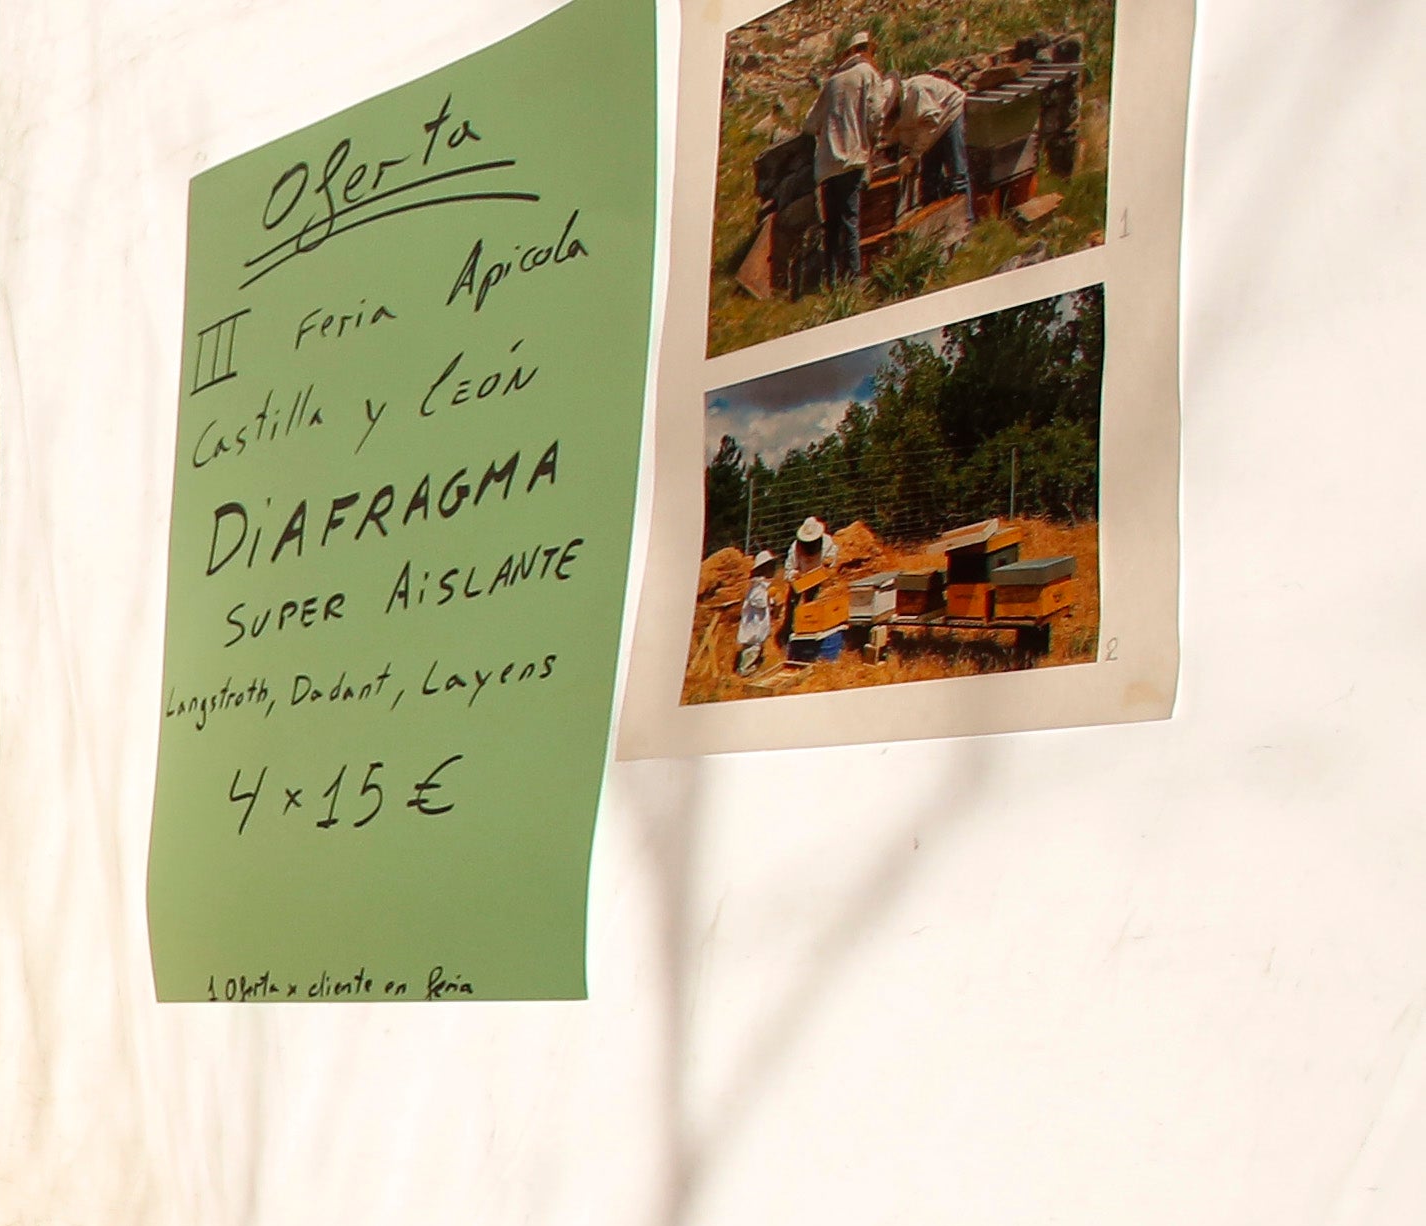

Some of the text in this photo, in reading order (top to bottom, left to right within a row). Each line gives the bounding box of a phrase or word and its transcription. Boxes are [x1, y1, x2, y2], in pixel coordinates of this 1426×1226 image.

[262, 93, 481, 252] Oferta
[190, 308, 251, 396] III
[295, 299, 396, 350] Feria
[192, 383, 323, 467] Castilla
[354, 399, 387, 454] y
[224, 593, 345, 647] SUPER
[165, 653, 557, 731] Langstroth, Dadant, Layens
[229, 766, 267, 835] 4
[316, 762, 384, 828] 15
[407, 754, 464, 815] €
[208, 975, 218, 1001] 1
[308, 967, 373, 998] cliente
[384, 980, 408, 997] en
